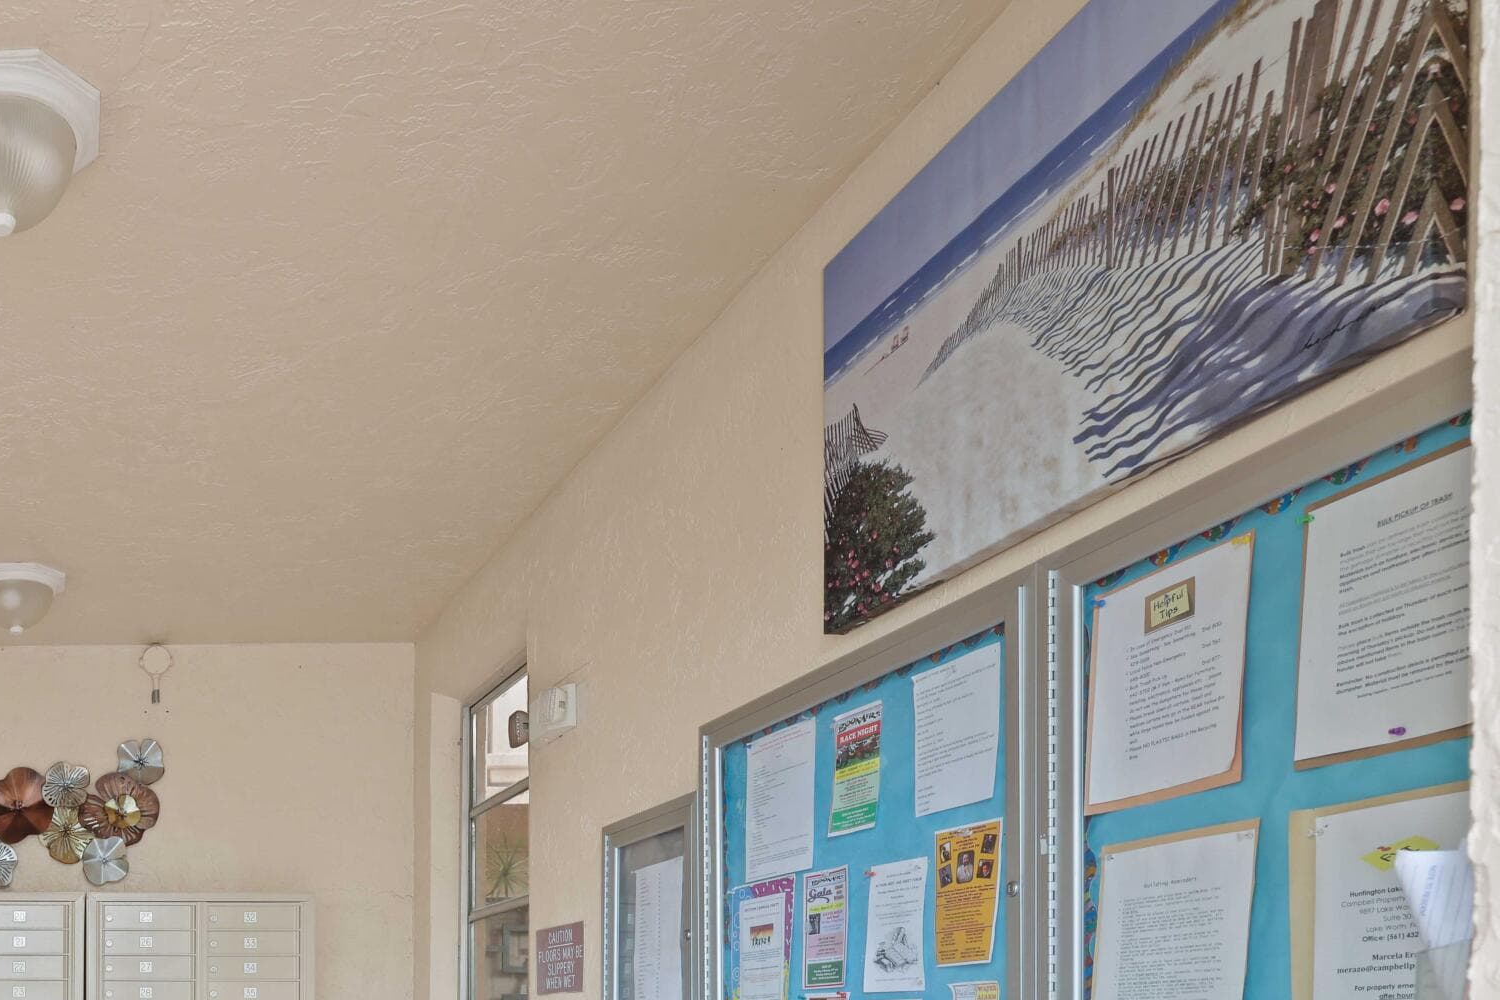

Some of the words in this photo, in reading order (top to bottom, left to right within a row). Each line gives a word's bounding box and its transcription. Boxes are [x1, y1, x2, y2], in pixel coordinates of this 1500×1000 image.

[1395, 506, 1418, 520] PICKUP
[1420, 501, 1430, 511] OF
[1153, 589, 1183, 611] Helpful
[1159, 606, 1178, 619] Tips
[840, 732, 857, 744] RACE
[857, 724, 878, 737] NIGHT
[807, 887, 833, 903] Gala
[1350, 887, 1386, 899] Huntington
[1388, 886, 1403, 894] Lak
[15, 912, 24, 920] 20
[141, 913, 150, 921] 25
[245, 912, 254, 921] 32
[548, 929, 573, 945] CAUTION
[1387, 933, 1405, 942] (561)
[16, 938, 23, 946] 21
[141, 938, 150, 946] 26
[538, 949, 560, 963] FLOORS
[562, 946, 575, 960] MAY
[576, 945, 584, 958] BE
[1372, 953, 1403, 961] Marcela
[141, 963, 151, 971] 27
[547, 961, 574, 977] SLIPPERY
[546, 976, 562, 990] WHEN
[563, 974, 576, 988] WET
[14, 988, 23, 996] 23
[141, 988, 150, 996] 28
[246, 988, 255, 997] 35
[1366, 984, 1395, 993] property
